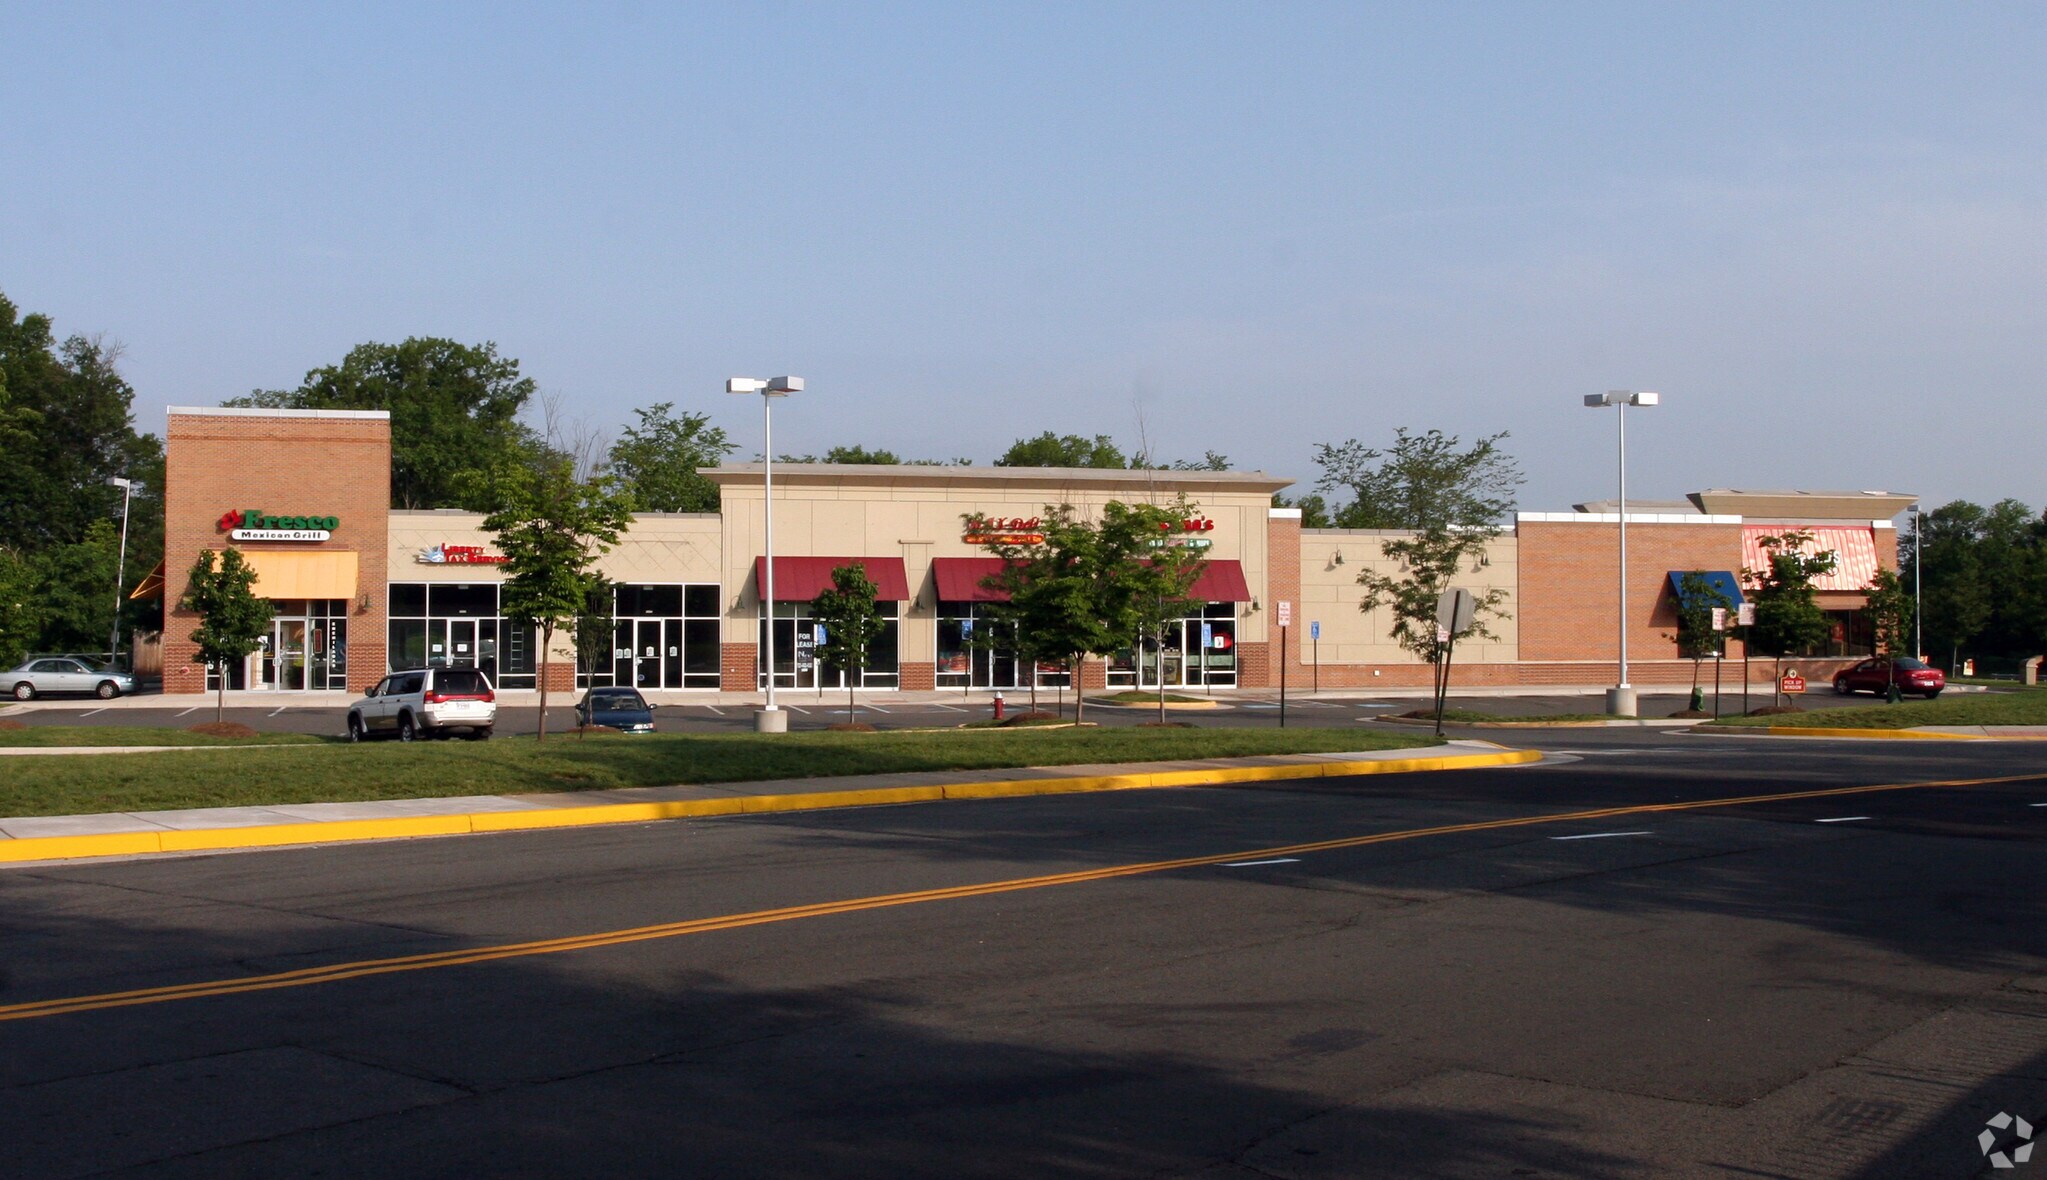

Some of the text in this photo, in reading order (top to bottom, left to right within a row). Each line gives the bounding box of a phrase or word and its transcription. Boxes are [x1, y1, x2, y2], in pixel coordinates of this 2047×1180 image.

[242, 509, 339, 530] Fresco
[241, 531, 321, 539] Mexican Grill
